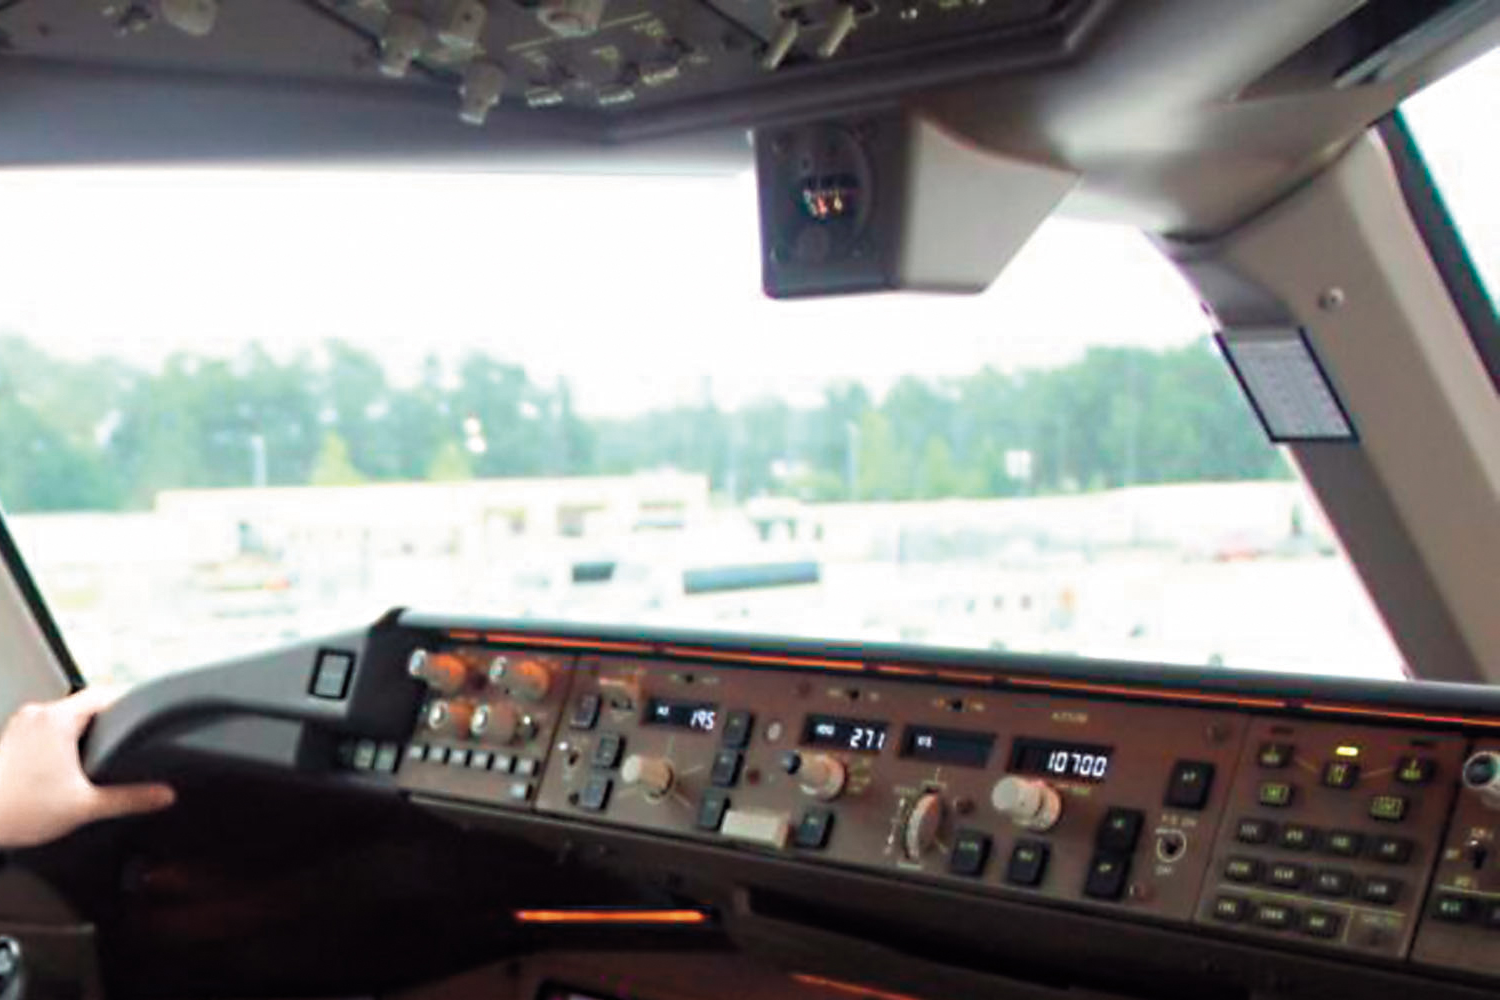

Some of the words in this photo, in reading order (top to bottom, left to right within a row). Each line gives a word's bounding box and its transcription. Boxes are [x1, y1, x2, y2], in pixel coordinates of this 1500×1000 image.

[688, 709, 715, 731] 195
[849, 727, 887, 750] 271
[1047, 751, 1108, 777] 10700
